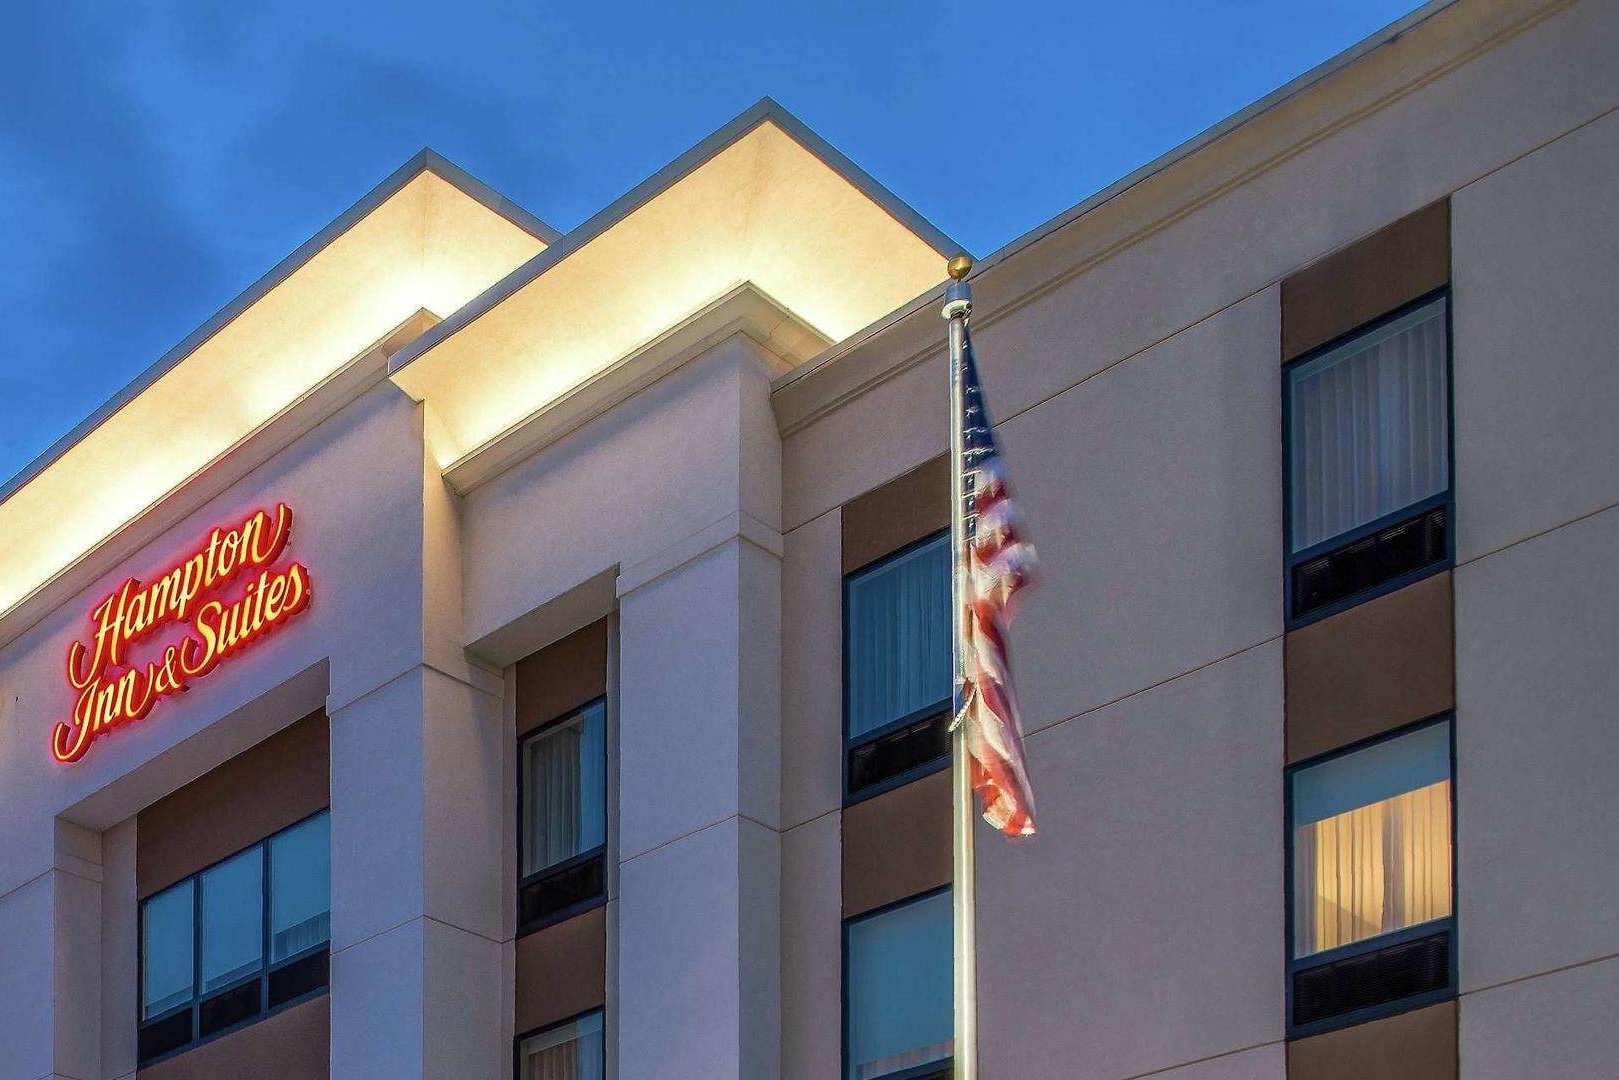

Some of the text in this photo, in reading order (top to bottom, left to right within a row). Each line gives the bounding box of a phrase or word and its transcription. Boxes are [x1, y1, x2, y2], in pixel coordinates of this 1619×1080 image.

[53, 563, 310, 763] Inn & Suites
[68, 502, 293, 690] Hampton
